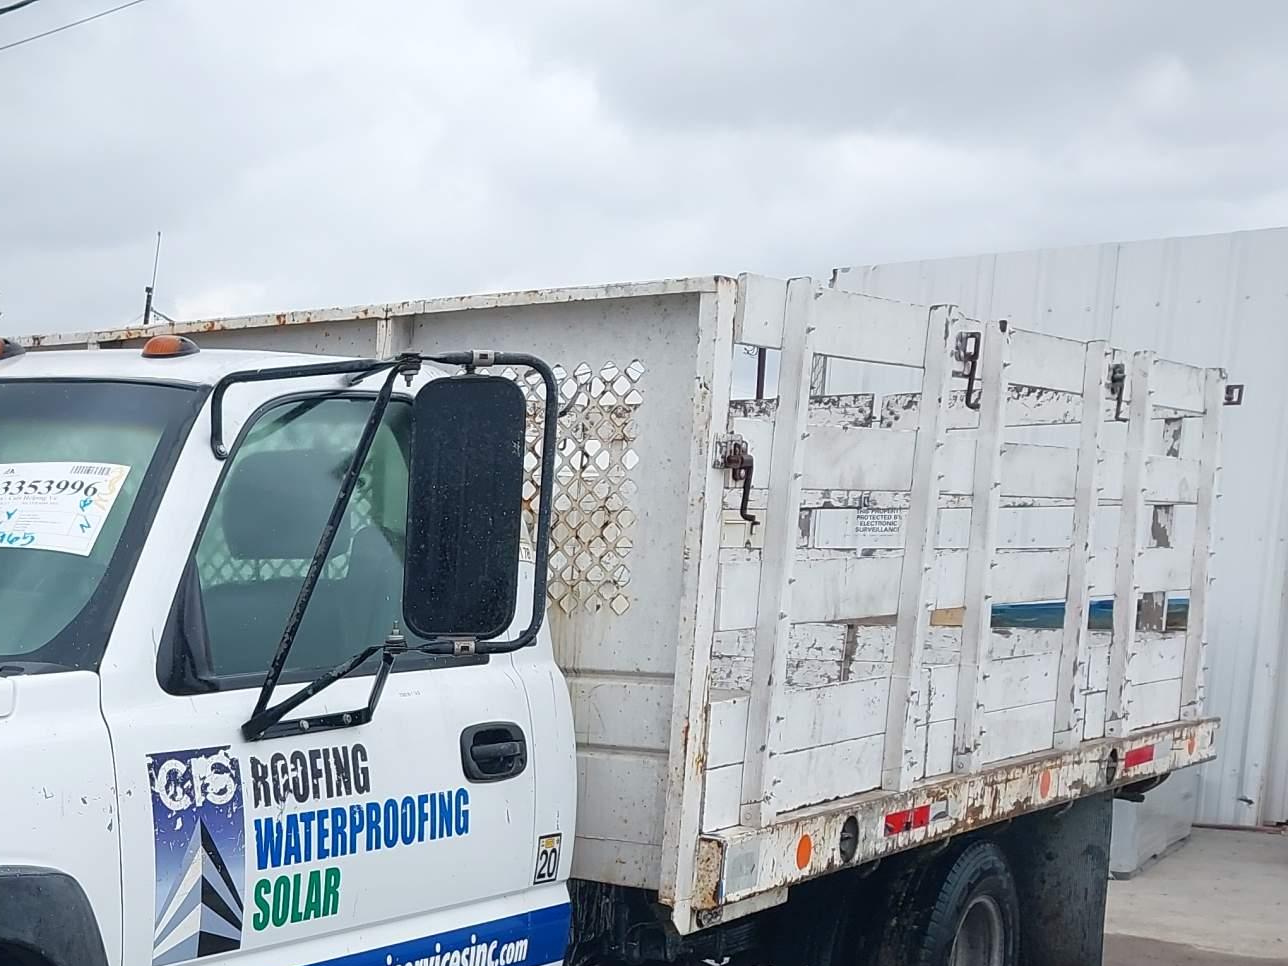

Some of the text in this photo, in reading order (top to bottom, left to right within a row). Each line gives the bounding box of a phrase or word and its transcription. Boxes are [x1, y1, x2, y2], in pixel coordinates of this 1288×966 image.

[250, 744, 370, 808] ROOFING
[254, 788, 469, 870] WATERPROOFING
[537, 848, 557, 879] 20
[253, 867, 340, 931] SOLAR
